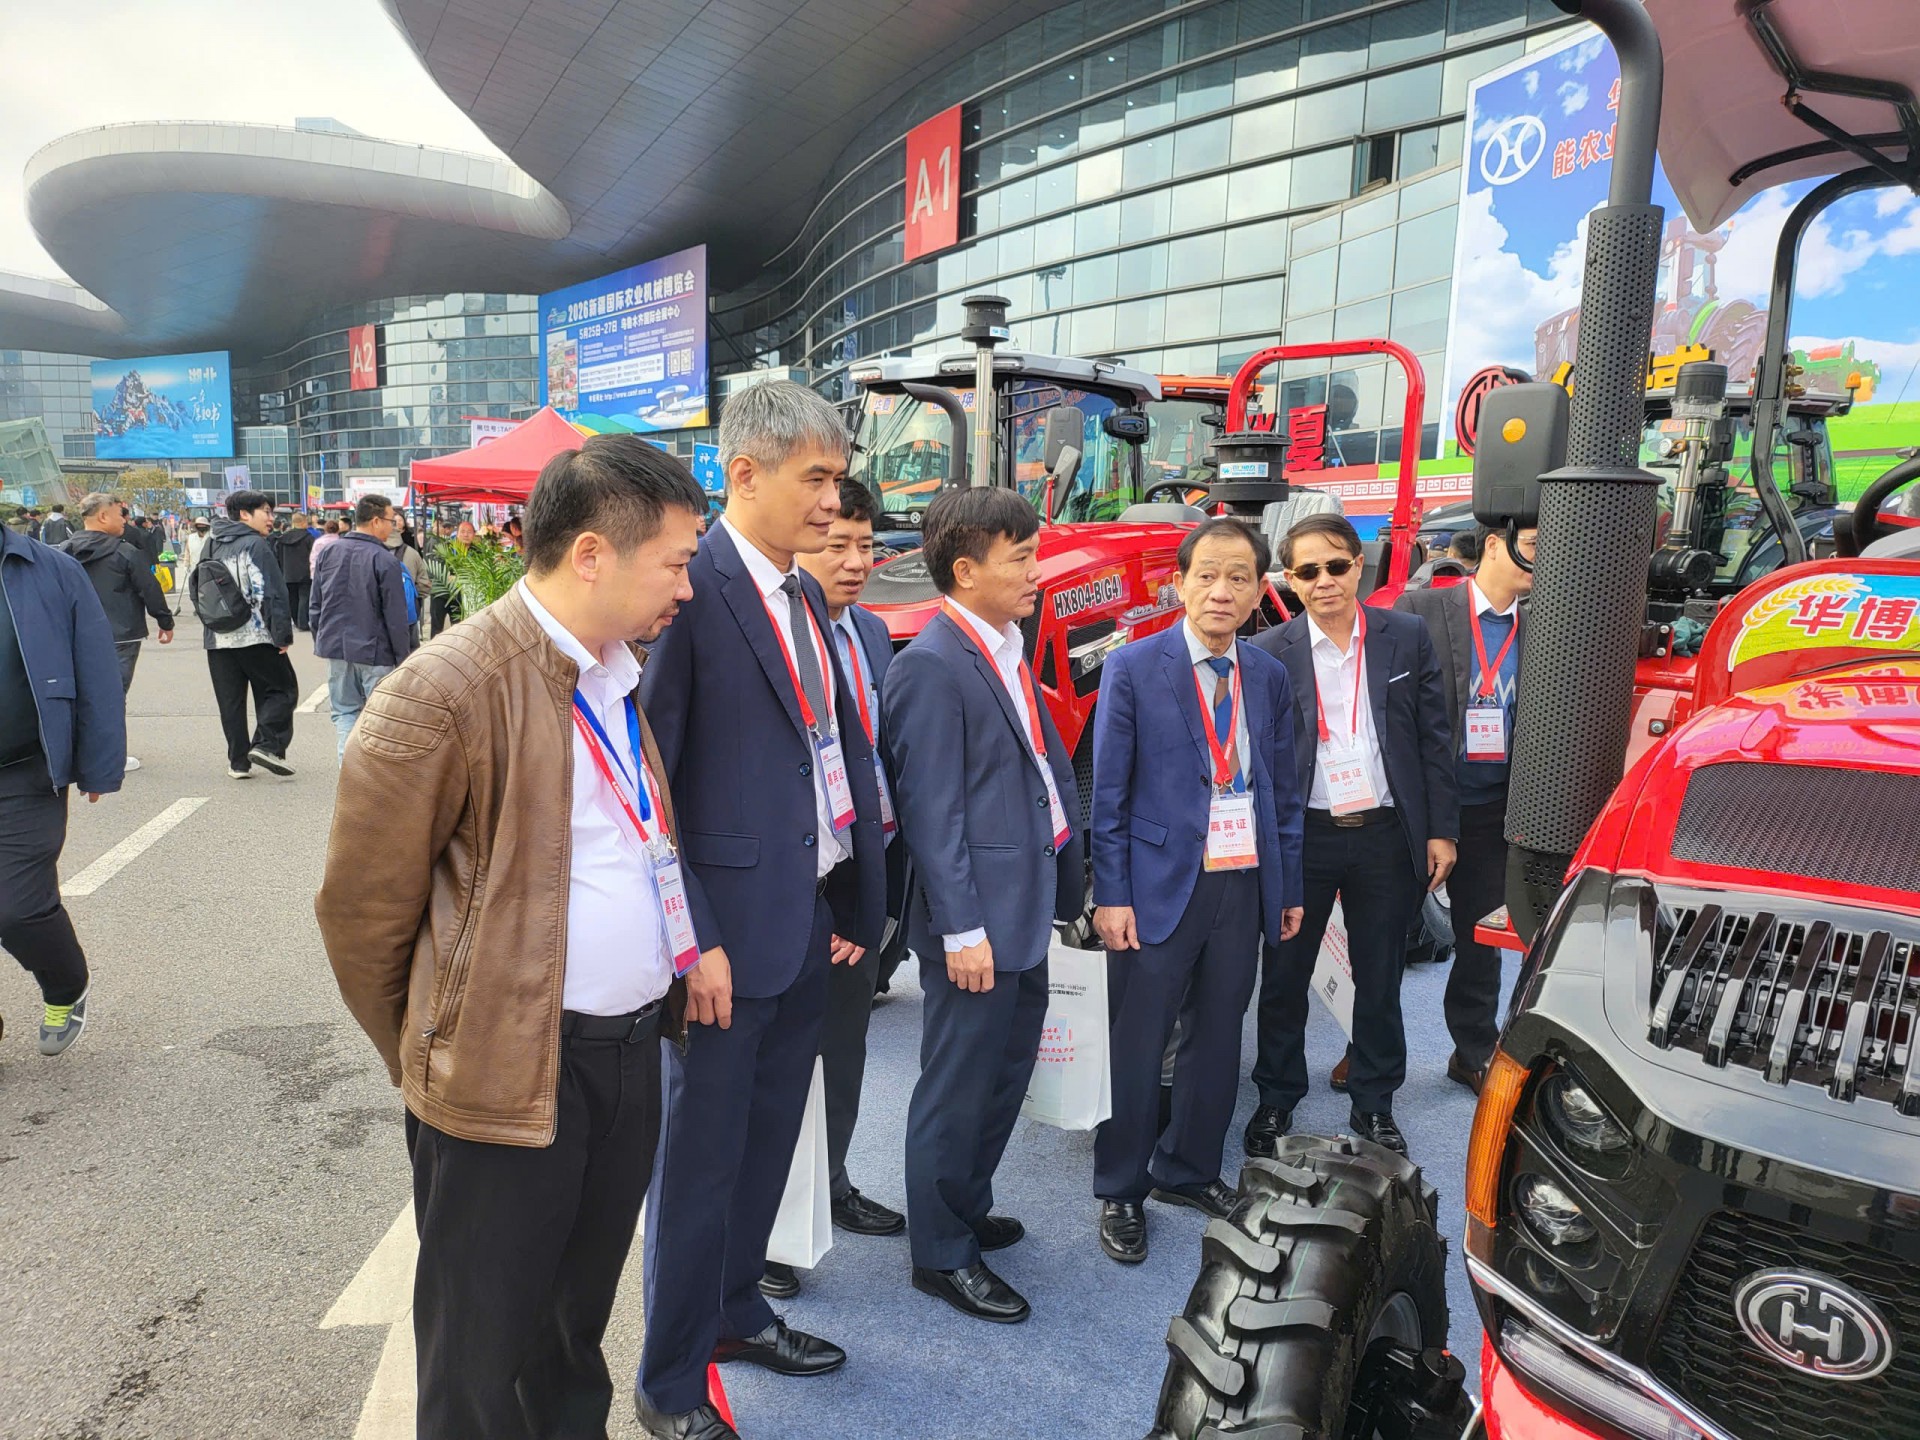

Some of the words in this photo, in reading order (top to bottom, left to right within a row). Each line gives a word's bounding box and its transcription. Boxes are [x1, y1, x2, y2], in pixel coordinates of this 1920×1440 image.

[911, 145, 951, 225] A1
[567, 269, 695, 323] 2026新疆国际农业机械博览会
[579, 320, 618, 340] 5月25日-27日
[352, 342, 374, 374] A2
[1053, 574, 1122, 619] HX804-B(G4)
[1789, 595, 1918, 639] 华博
[1210, 818, 1248, 832] 嘉宾证
